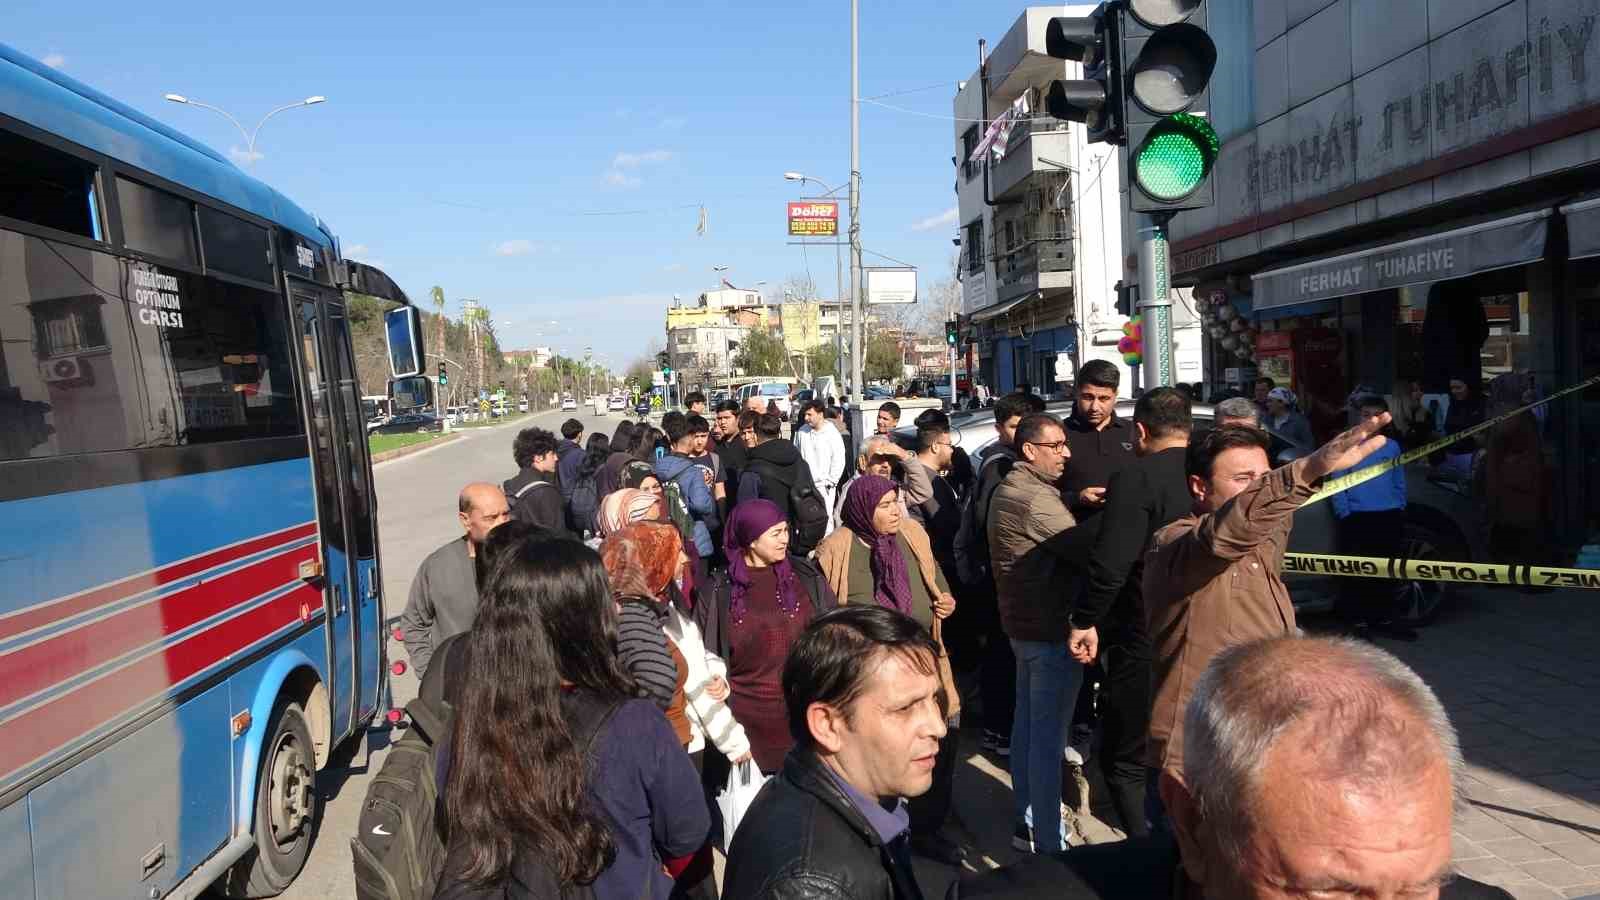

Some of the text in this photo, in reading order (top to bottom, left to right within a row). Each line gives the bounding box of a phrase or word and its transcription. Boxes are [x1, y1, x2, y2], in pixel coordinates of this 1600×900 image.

[1300, 248, 1454, 294] FERHAT TUHAFİYE
[1282, 556, 1379, 576] GİRİLME
